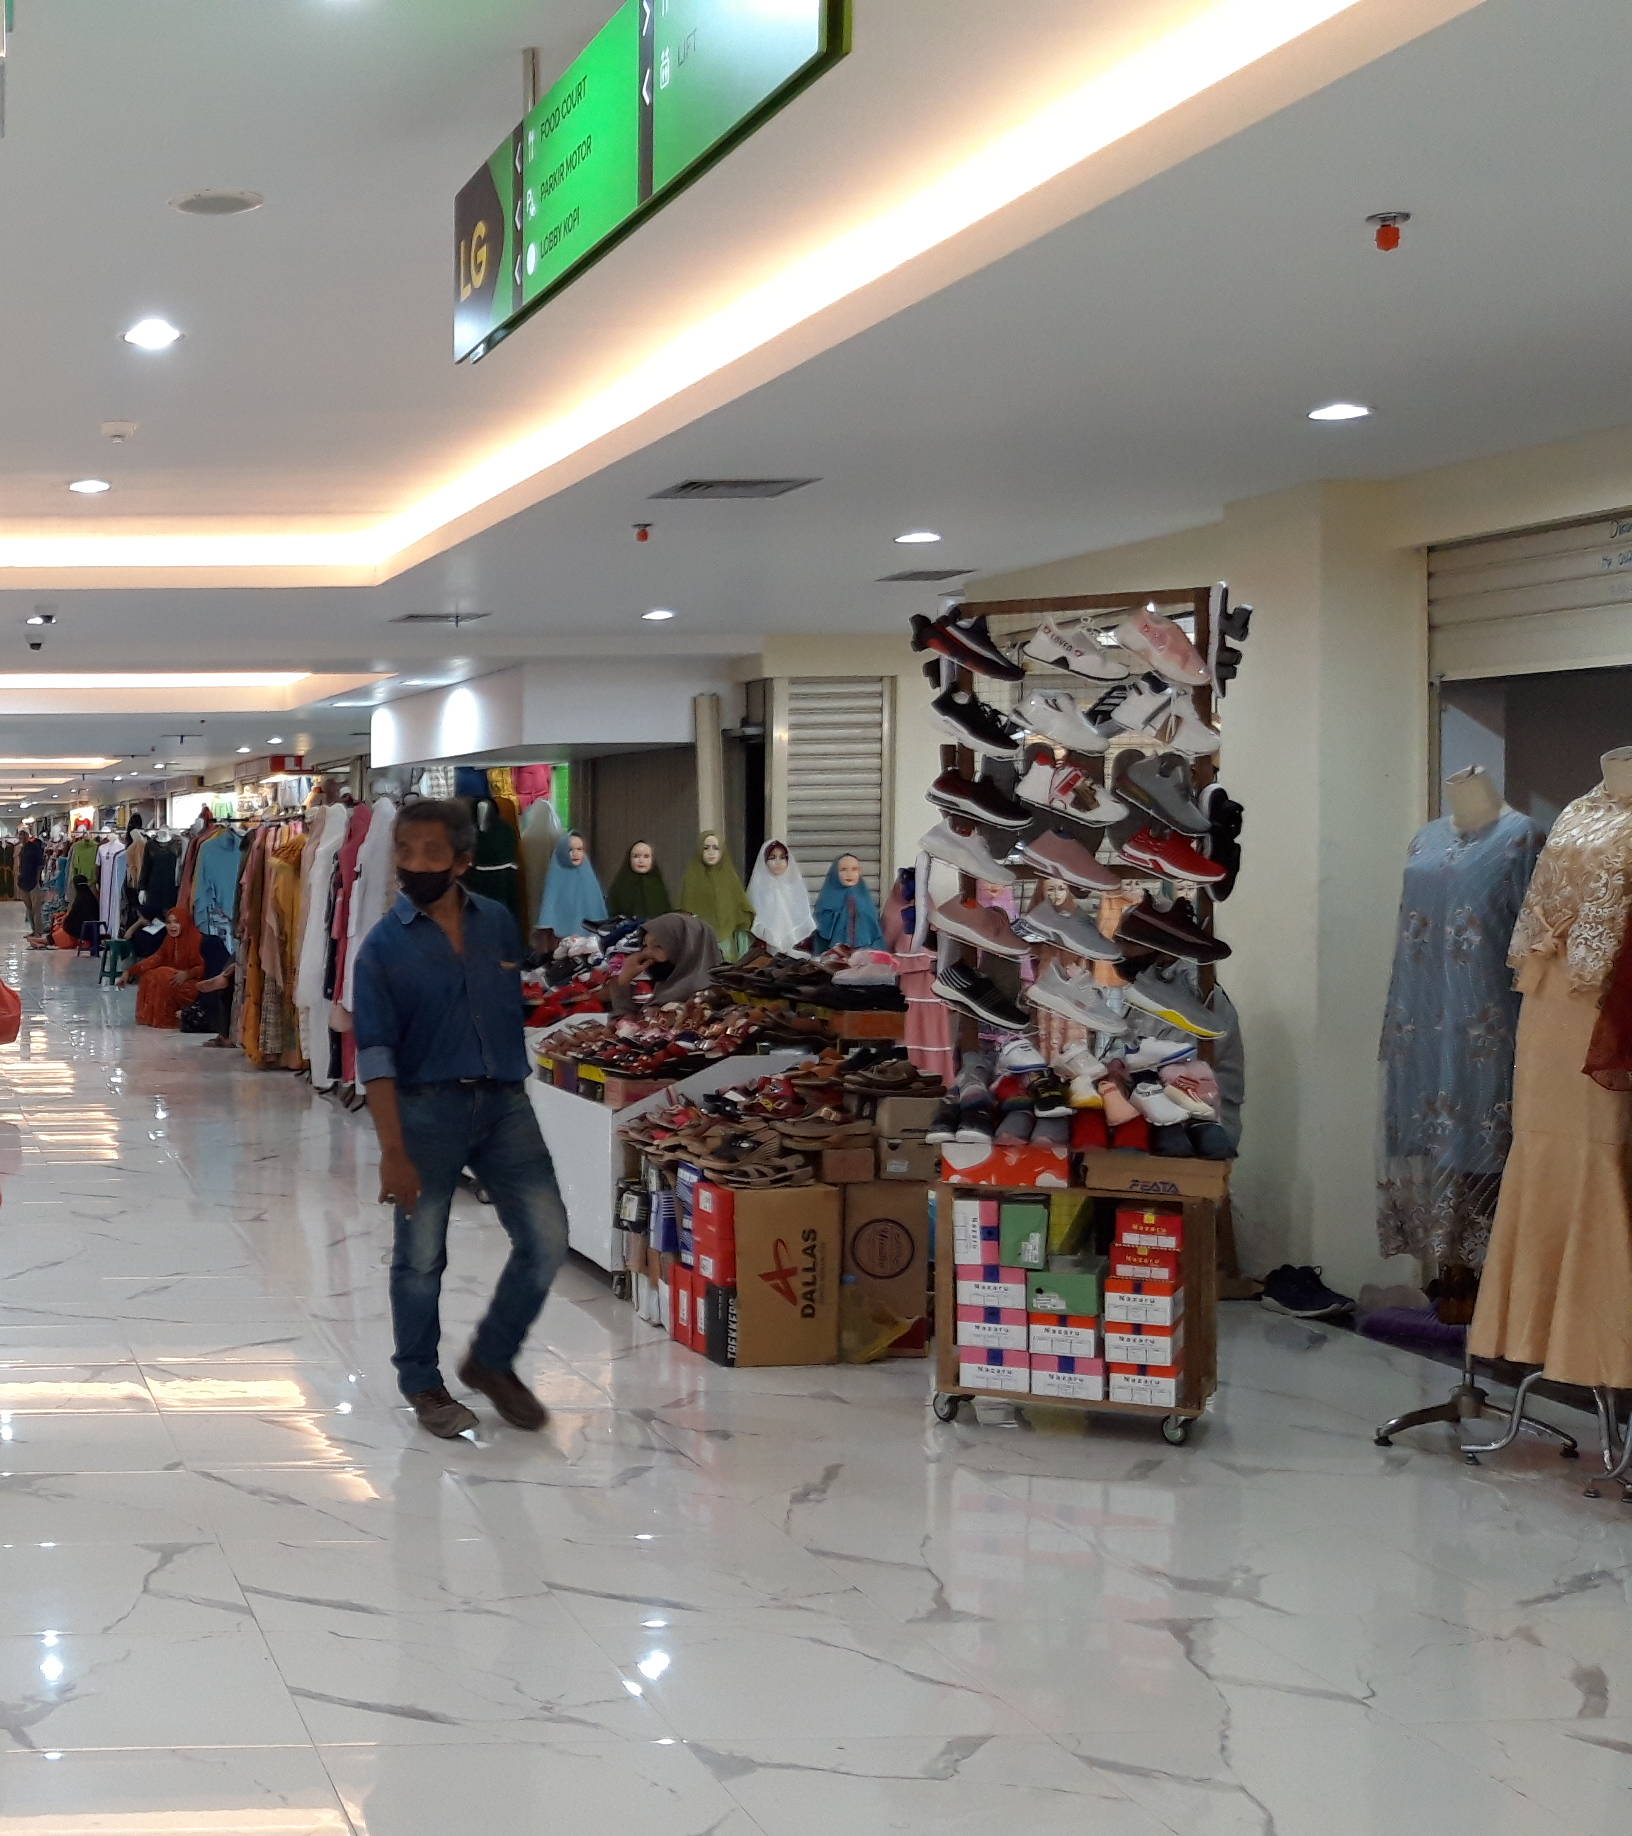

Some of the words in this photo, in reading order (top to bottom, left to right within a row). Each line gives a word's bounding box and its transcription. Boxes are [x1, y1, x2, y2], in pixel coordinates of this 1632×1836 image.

[677, 27, 697, 67] LIFT
[540, 107, 561, 142] FOOD
[561, 74, 588, 119] COURT
[540, 161, 565, 202] PARKIR
[565, 134, 592, 178] MOTOR
[460, 220, 489, 302] LG
[540, 223, 563, 259] LOBBY
[562, 205, 580, 238] KOPI
[800, 1227, 818, 1320] DALLAS
